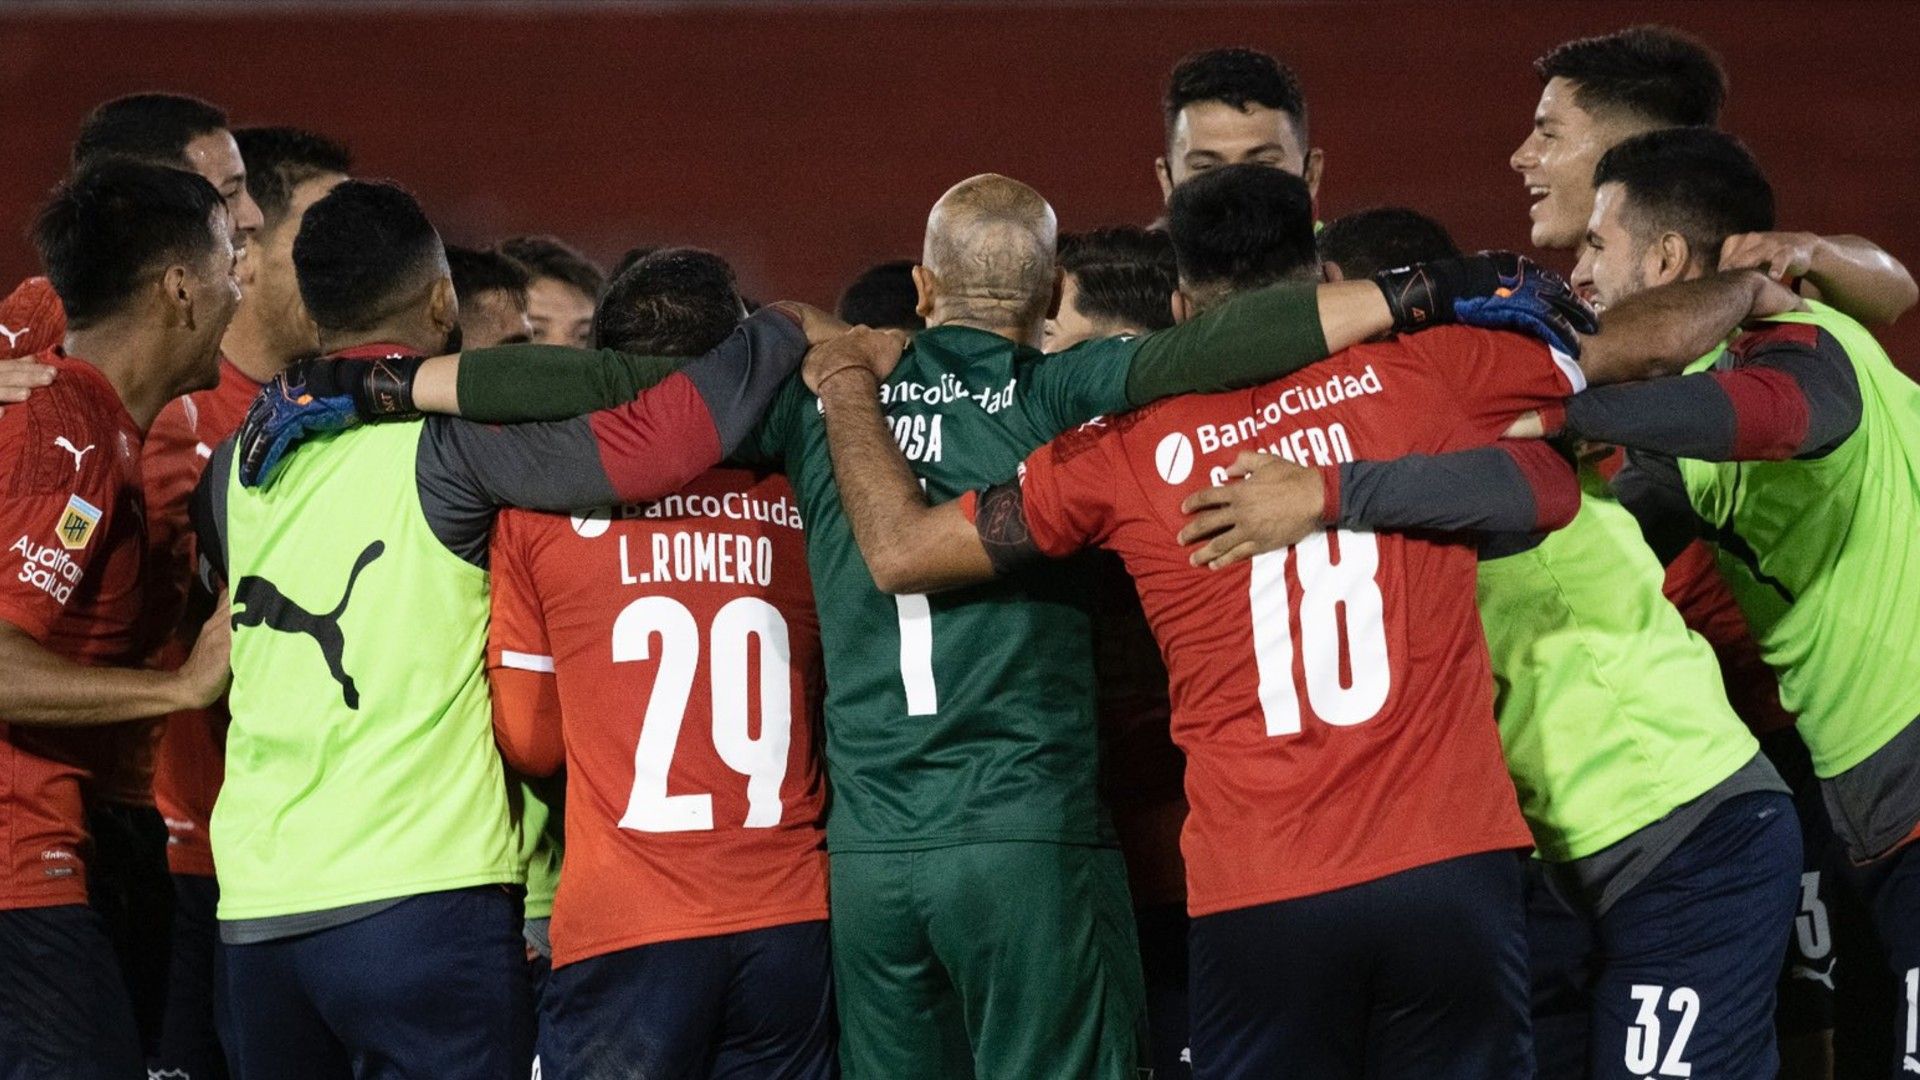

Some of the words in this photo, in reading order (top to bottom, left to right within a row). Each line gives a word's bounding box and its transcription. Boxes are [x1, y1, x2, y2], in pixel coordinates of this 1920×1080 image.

[886, 414, 943, 462] OSA
[1196, 364, 1383, 455] BancoCiudad
[620, 492, 804, 530] BancoCiuda
[18, 561, 74, 605] Salud
[619, 531, 773, 587] L.ROMERO
[1249, 529, 1391, 737] 18
[612, 596, 792, 832] 29
[1624, 984, 1700, 1078] 32
